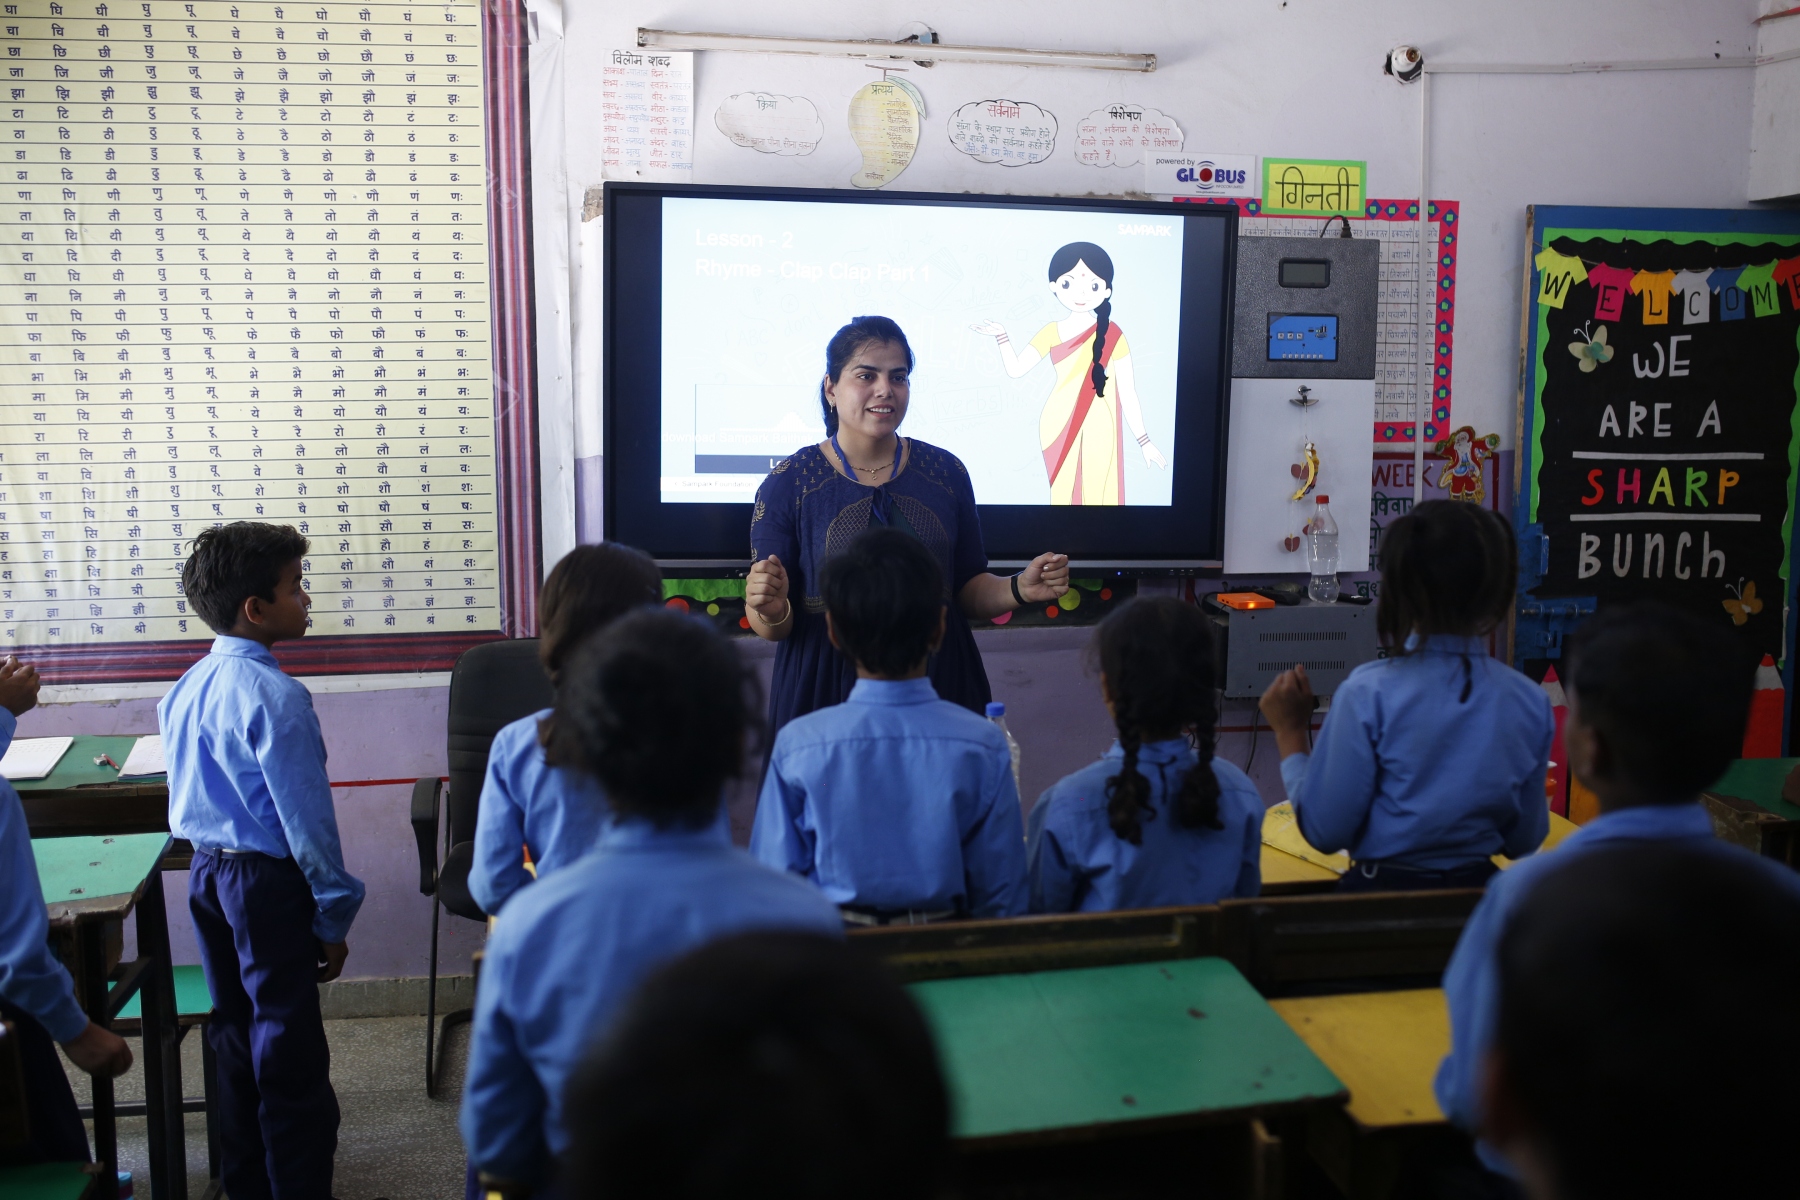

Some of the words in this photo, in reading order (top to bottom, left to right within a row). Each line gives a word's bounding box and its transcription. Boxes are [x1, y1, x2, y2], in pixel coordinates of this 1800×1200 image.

[5, 25, 20, 36] चा
[50, 22, 65, 37] चि
[96, 23, 110, 38] ची
[142, 24, 153, 39] चु
[185, 24, 199, 39] चू
[230, 25, 241, 40] चे
[274, 26, 286, 41] चै
[315, 27, 329, 42] चो
[358, 28, 373, 42] चौ
[403, 29, 414, 43] चं
[611, 50, 643, 66] विलोम
[648, 55, 672, 68] शब्द
[871, 84, 895, 96] प्रत्यय
[755, 96, 778, 111] क्रिया
[987, 100, 1021, 119] सर्वनाम
[1108, 106, 1143, 122] विशेषण
[1155, 158, 1186, 167] powered
[1186, 158, 1196, 168] by
[1176, 167, 1246, 184] GLOBUS
[1274, 166, 1360, 211] गिनती
[18, 211, 33, 222] ता
[63, 207, 77, 222] ति
[107, 208, 121, 222] ती
[152, 207, 164, 222] तु
[195, 207, 208, 222] तू
[239, 208, 250, 222] ते
[283, 208, 294, 222] तै
[323, 208, 337, 222] तो
[366, 208, 380, 222] तौ
[409, 209, 420, 222] तं
[695, 228, 764, 248] Lesson
[781, 231, 794, 249] 2
[1117, 223, 1172, 237] SAMPARK
[695, 258, 762, 281] Rhyme
[780, 260, 823, 284] Clap
[829, 261, 872, 285] Clap
[877, 263, 916, 282] Part
[921, 264, 930, 282] 1
[25, 312, 39, 323] पा
[69, 308, 83, 322] पि
[113, 308, 127, 322] पी
[158, 307, 169, 322] पु
[200, 307, 213, 321] पू
[244, 307, 255, 321] पे
[287, 306, 298, 321] पै
[328, 306, 341, 320] पो
[370, 306, 383, 320] पौ
[413, 306, 423, 320] पं
[1632, 334, 1692, 379] WE
[1599, 400, 1672, 439] ARE
[1696, 399, 1722, 438] A
[33, 432, 46, 442] रा
[77, 427, 90, 442] रि
[121, 427, 133, 441] री
[165, 426, 175, 440] रु
[207, 425, 218, 439] रू
[250, 425, 260, 439] रे
[291, 424, 303, 438] रै
[333, 423, 345, 437] रो
[374, 422, 387, 437] रौ
[417, 423, 426, 436] रं
[662, 431, 716, 444] download
[719, 431, 770, 446] Sampark
[681, 480, 713, 490] Sampark
[714, 480, 754, 488] Foundation
[1581, 466, 1740, 508] SHARP
[40, 530, 56, 540] सा
[83, 525, 99, 539] सि
[126, 524, 142, 538] सी
[171, 523, 183, 537] सु
[298, 520, 310, 534] सै
[337, 519, 352, 533] सो
[378, 518, 394, 532] सौ
[421, 518, 433, 531] सं
